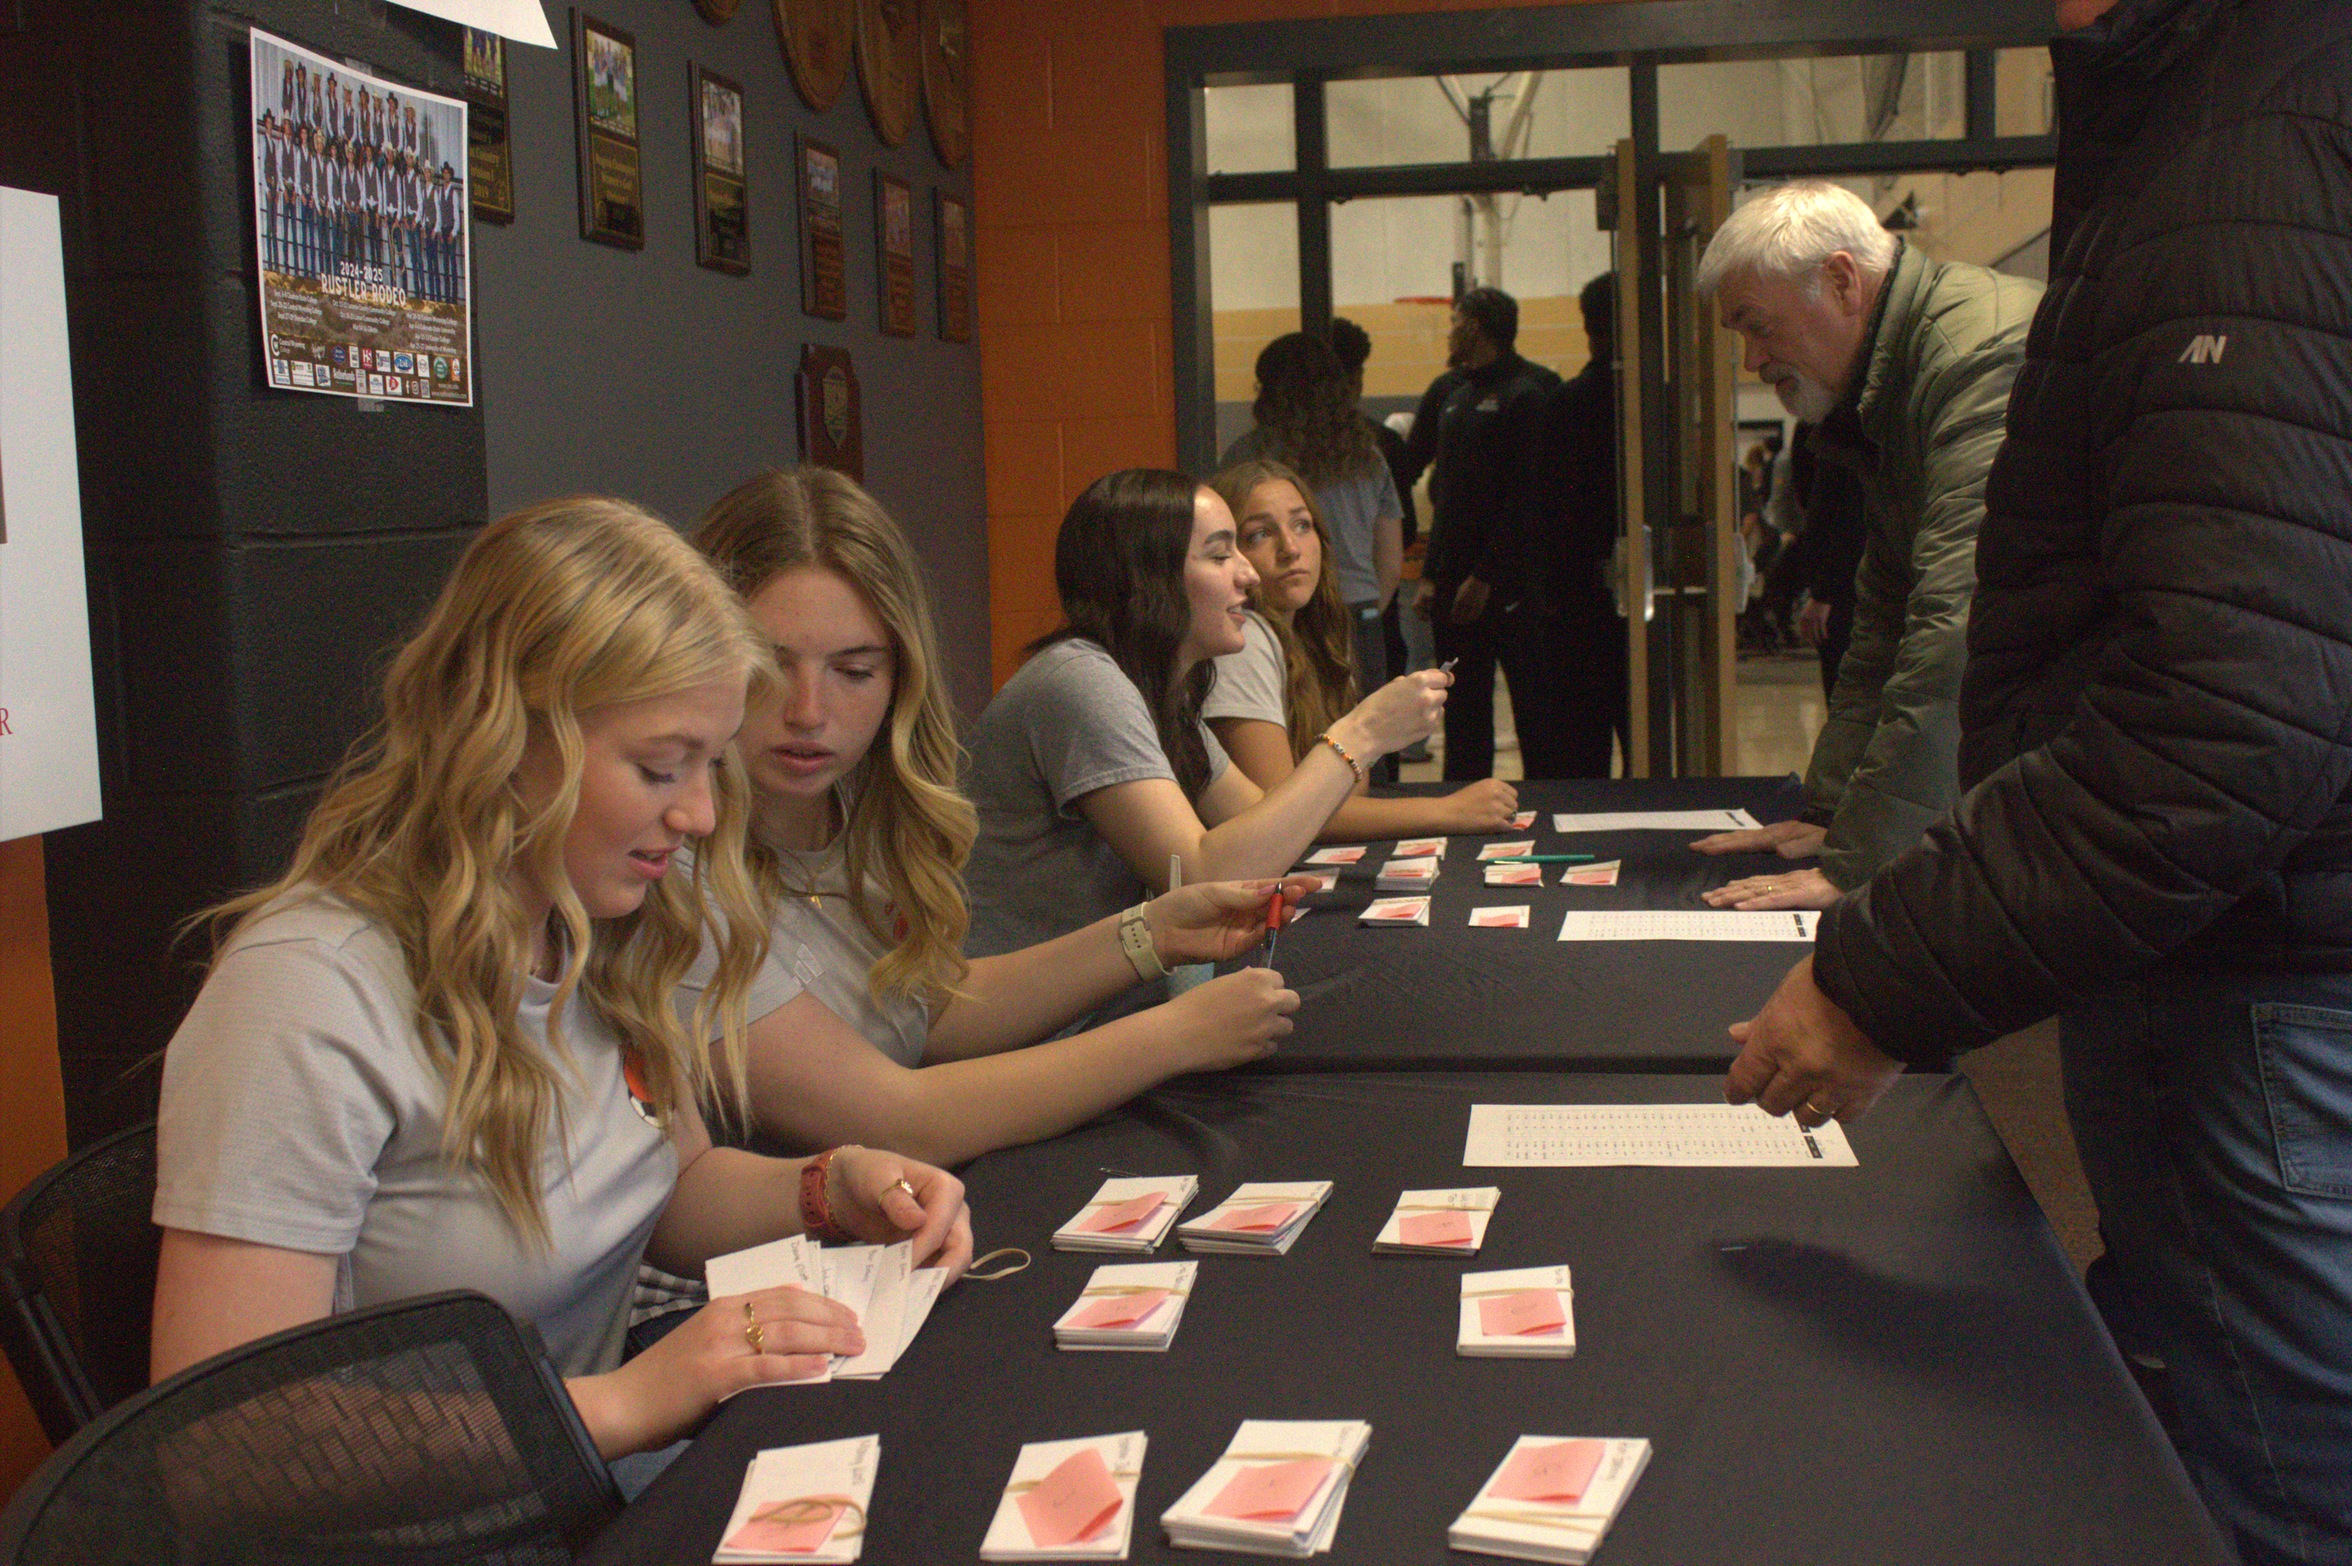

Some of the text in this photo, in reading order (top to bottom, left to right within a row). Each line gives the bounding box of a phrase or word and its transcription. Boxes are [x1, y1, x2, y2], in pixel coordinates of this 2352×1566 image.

[340, 261, 384, 282] 2024-2025
[320, 272, 368, 300] RUSTLER
[371, 283, 407, 307] RODEO
